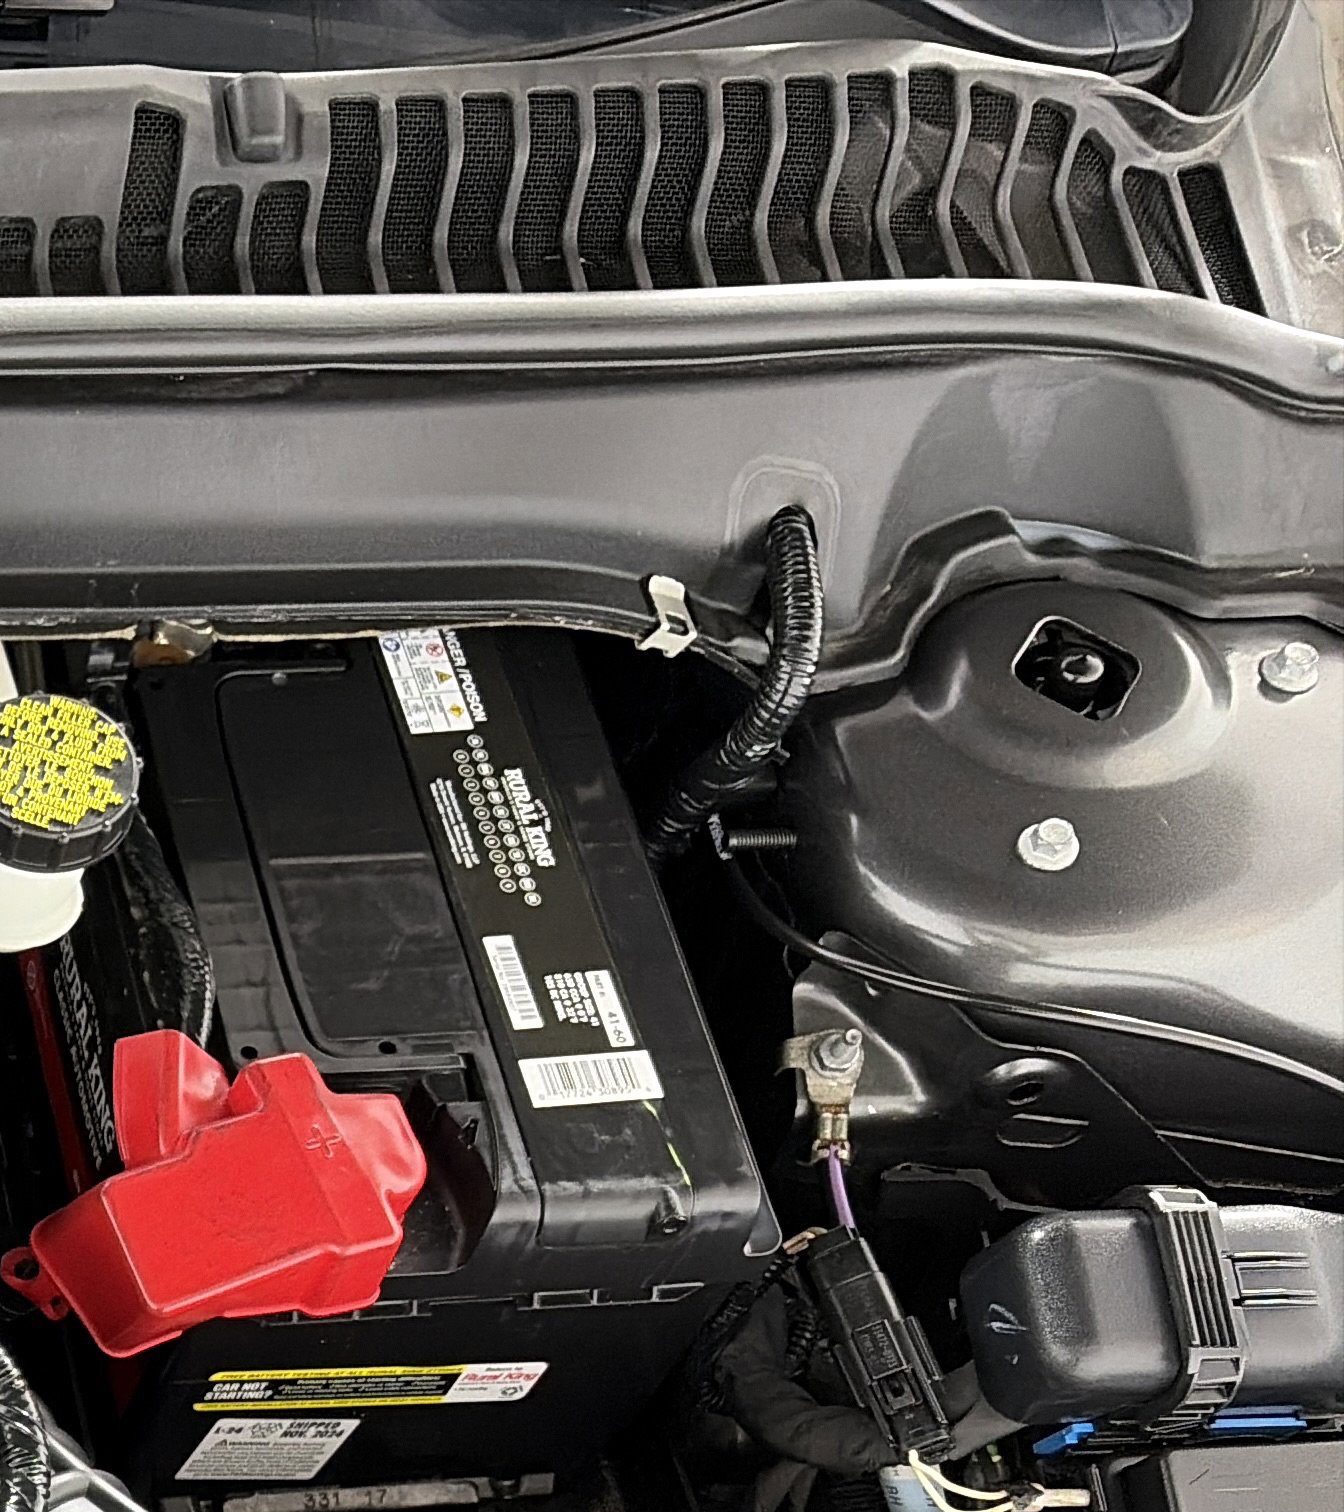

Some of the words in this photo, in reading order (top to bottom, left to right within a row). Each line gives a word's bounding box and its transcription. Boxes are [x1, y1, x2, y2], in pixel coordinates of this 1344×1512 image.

[3, 703, 43, 724] BEFORE
[105, 734, 126, 750] USE
[20, 697, 53, 717] CLEAN
[56, 708, 92, 729] FILLER
[95, 720, 117, 735] CAP
[0, 725, 9, 738] A
[13, 728, 52, 749] SEALED
[27, 721, 48, 738] DOT
[51, 729, 59, 741] 4
[63, 733, 93, 751] FLUID
[96, 742, 127, 762] FROM
[8, 761, 24, 774] DE
[26, 765, 40, 780] LE
[44, 759, 59, 773] LE
[64, 767, 115, 789] BOUCHON
[23, 777, 45, 792] QUE
[48, 783, 64, 798] DU
[67, 789, 106, 813] LIQUIDE
[28, 789, 88, 816] PROVENANT
[22, 798, 81, 826] CONTENANT
[502, 767, 539, 825] RURAL
[524, 825, 556, 868] KING
[608, 1011, 627, 1043] 41-60
[59, 932, 91, 1061] RURAL
[88, 1052, 115, 1153] KING
[212, 1382, 240, 1392] CAR
[240, 1381, 269, 1391] NOT
[462, 1373, 502, 1382] Rural
[503, 1372, 540, 1382] King
[203, 1390, 274, 1401] STARTING?
[279, 1430, 308, 1439] NOV.
[311, 1429, 345, 1439] 2024
[287, 1421, 342, 1430] SHIPPED
